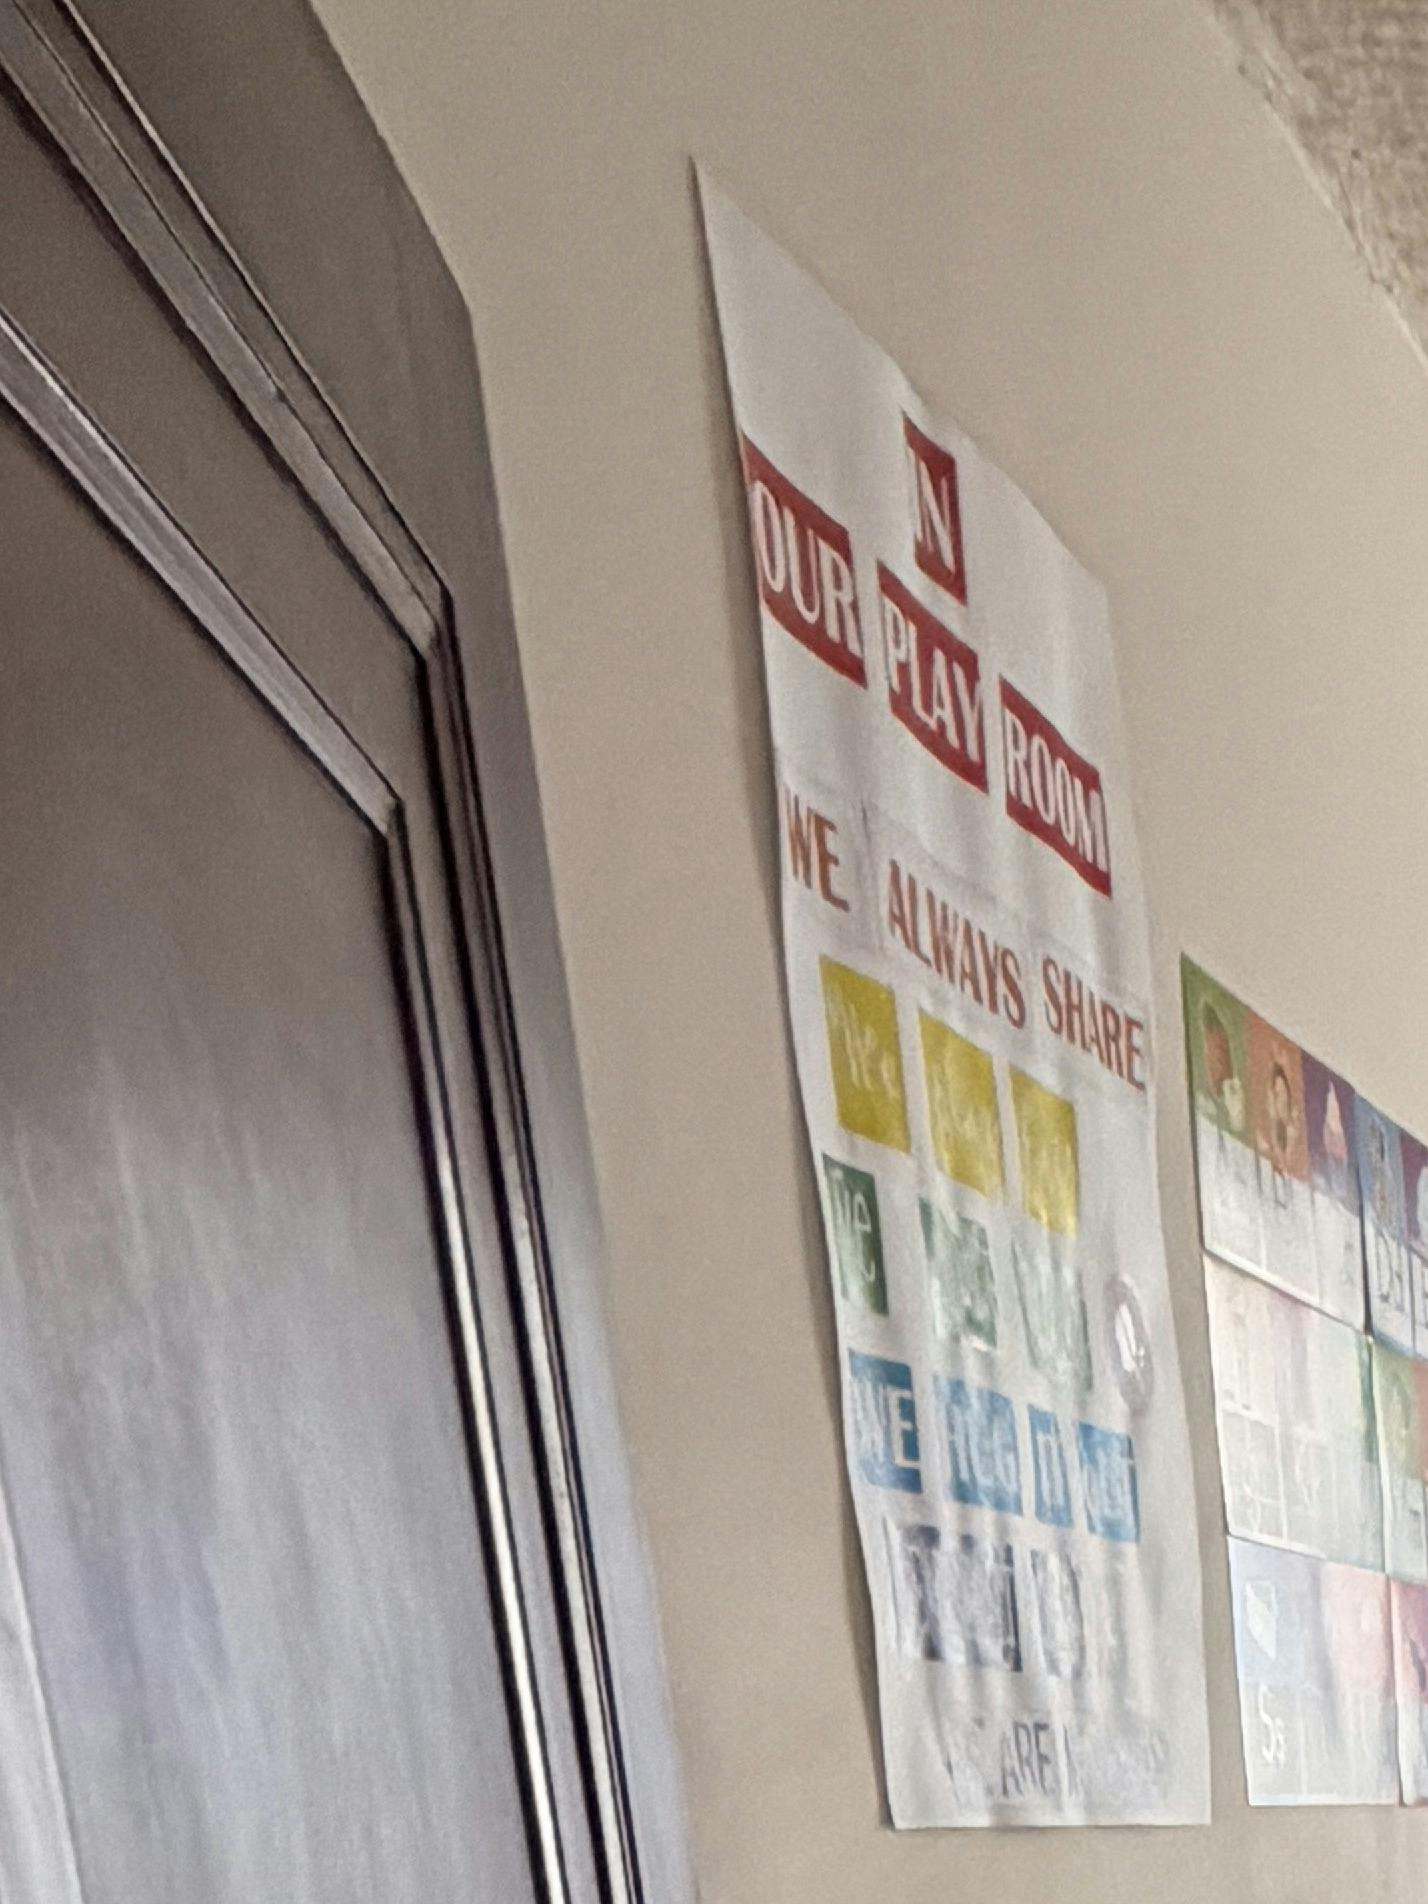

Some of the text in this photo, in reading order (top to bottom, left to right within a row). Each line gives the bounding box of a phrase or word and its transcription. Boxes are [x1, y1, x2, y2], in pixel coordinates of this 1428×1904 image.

[753, 480, 1109, 873] OUR PLAY ROOM
[779, 785, 850, 912] WE
[888, 858, 1026, 1030] ALWAYS
[1042, 953, 1146, 1093] SHARE
